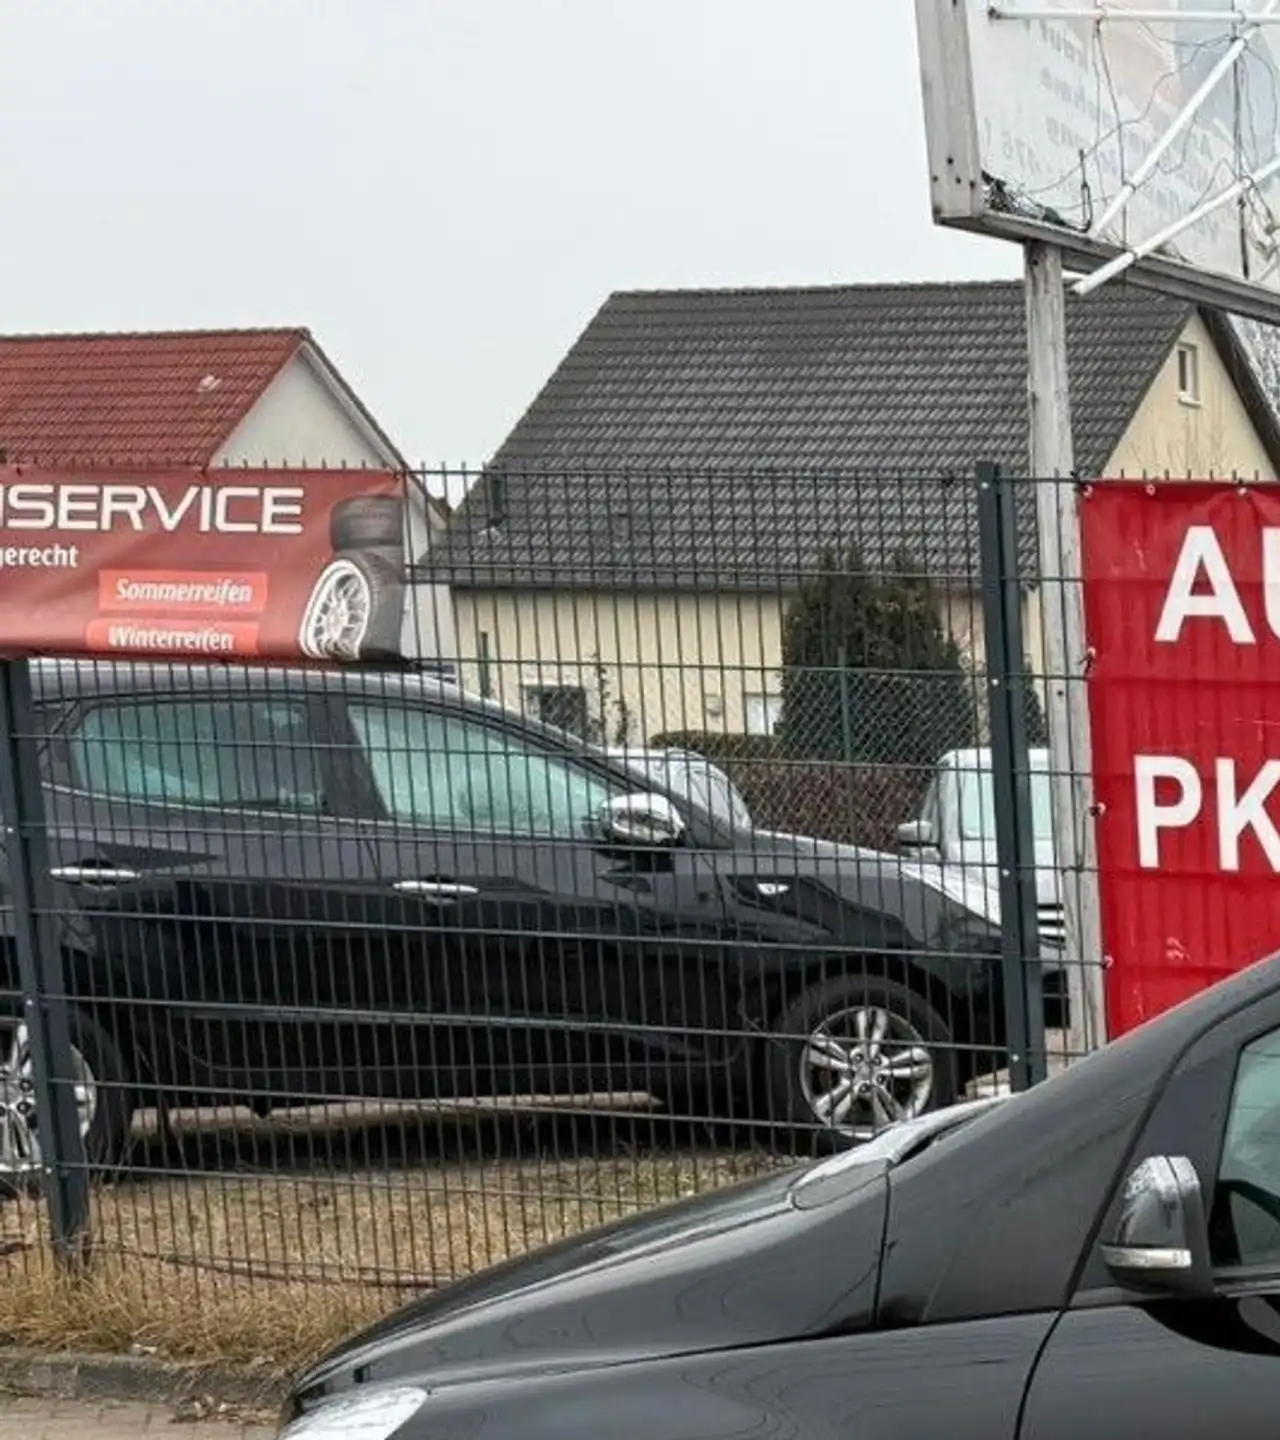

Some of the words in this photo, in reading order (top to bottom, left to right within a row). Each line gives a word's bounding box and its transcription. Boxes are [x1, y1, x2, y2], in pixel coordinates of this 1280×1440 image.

[0, 483, 304, 534] SERVICE
[116, 577, 253, 606] Sommerreifen
[108, 625, 235, 652] Winterreifen
